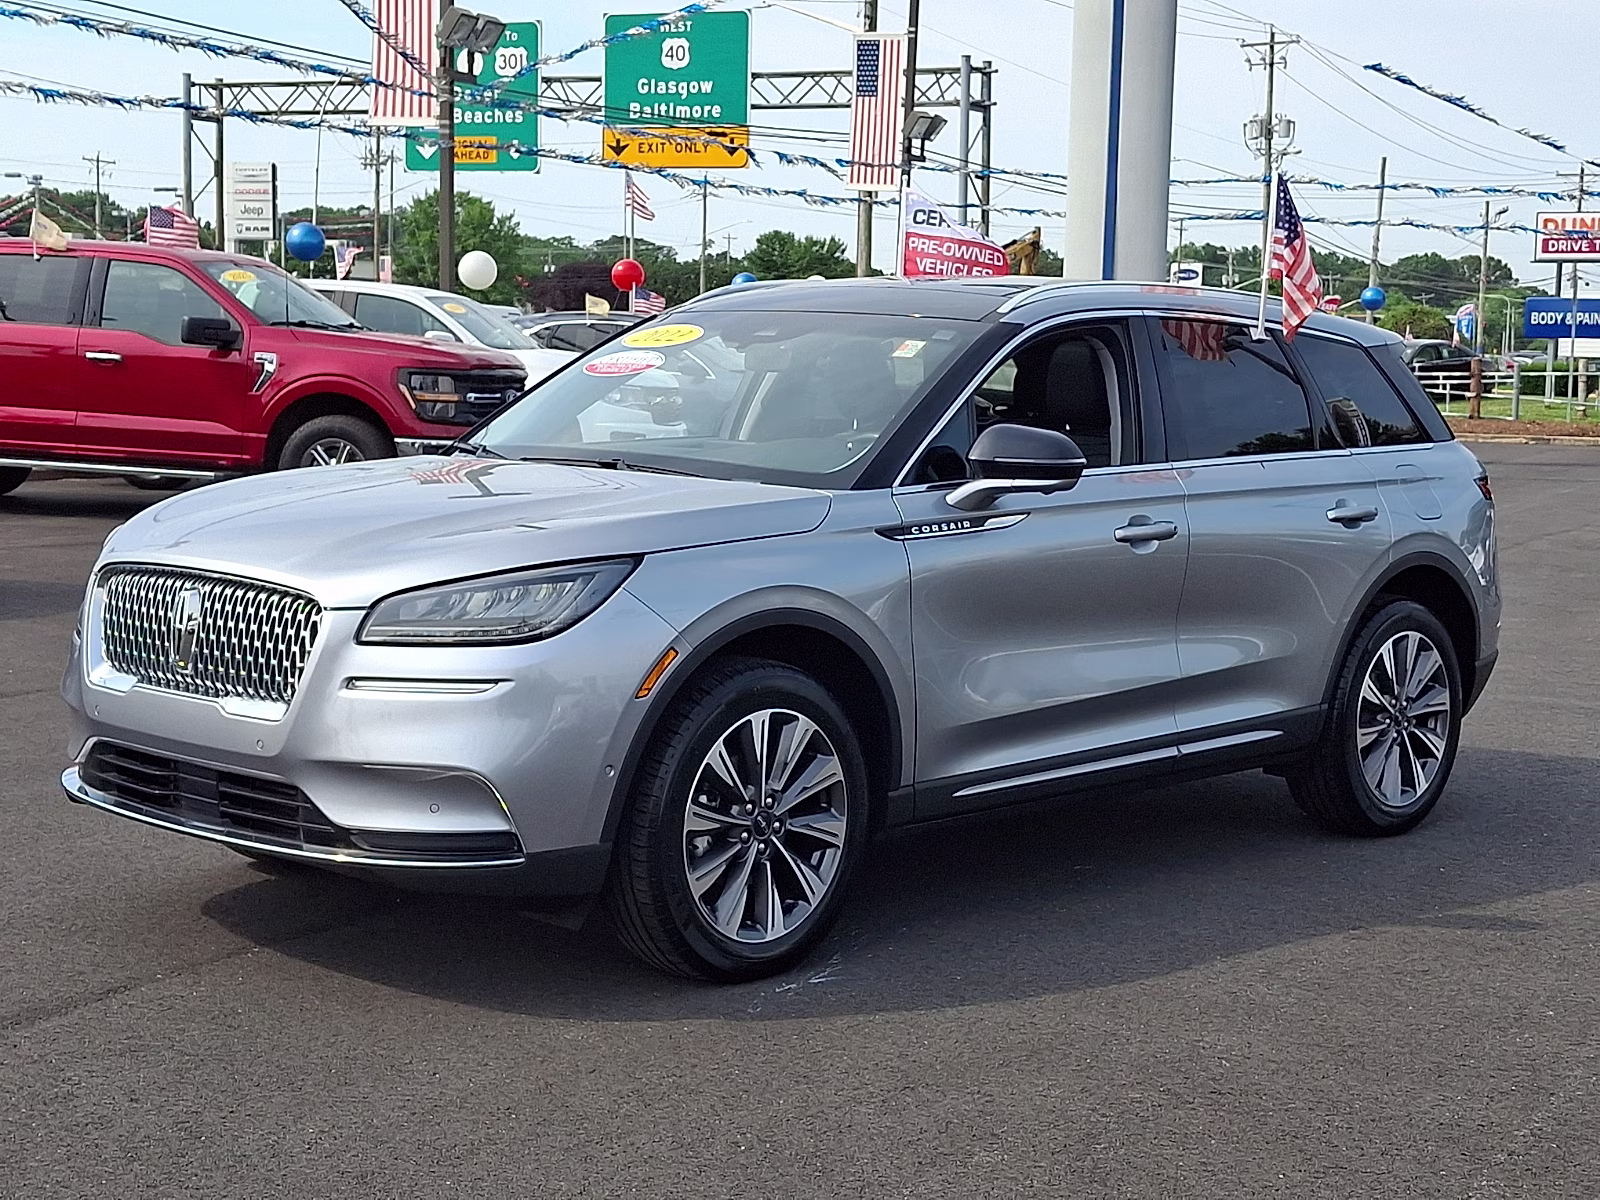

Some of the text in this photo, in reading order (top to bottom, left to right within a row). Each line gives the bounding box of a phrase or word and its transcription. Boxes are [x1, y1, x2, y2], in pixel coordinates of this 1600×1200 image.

[664, 45, 686, 61] 40
[498, 53, 523, 70] 301
[637, 78, 714, 100] Glasgow
[453, 107, 524, 123] Beaches
[629, 102, 721, 119] Baltimore
[453, 150, 490, 160] AHEAD
[638, 142, 709, 154] EXIT ONLY
[240, 204, 264, 217] Jeep
[1543, 217, 1600, 234] DUN
[908, 237, 1004, 266] PRE-OWNED
[1548, 239, 1590, 252] DRIVE
[915, 257, 993, 277] VEHICLES
[1530, 311, 1564, 325] BODY
[1564, 312, 1573, 325] &
[911, 520, 971, 534] CORSAIR
